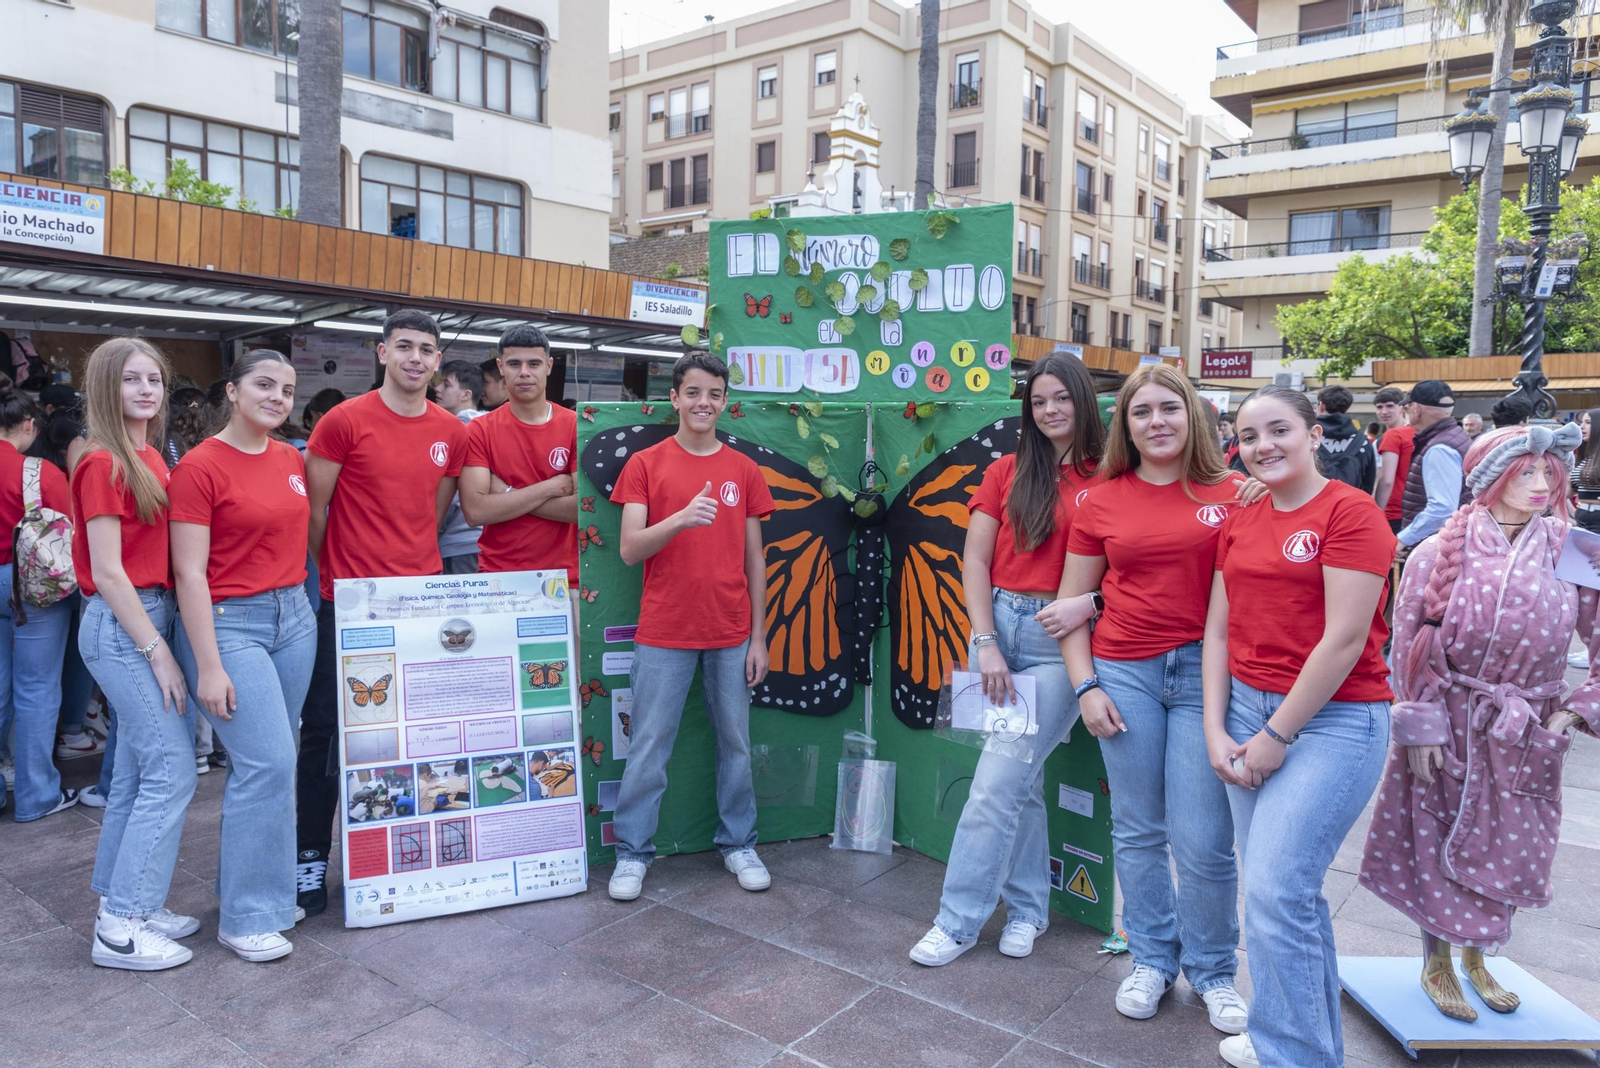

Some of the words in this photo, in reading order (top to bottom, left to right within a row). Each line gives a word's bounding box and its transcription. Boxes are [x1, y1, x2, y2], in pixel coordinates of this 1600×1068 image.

[0, 183, 82, 206] CIENCIA
[0, 210, 18, 225] io
[23, 213, 95, 235] Machado
[3, 226, 12, 236] la
[14, 228, 74, 245] Concepción)
[728, 234, 778, 276] EL
[645, 284, 699, 298] DIVERCIENCIA
[645, 301, 658, 312] IES
[659, 302, 693, 316] Saladillo
[819, 321, 842, 344] en
[883, 320, 901, 345] la
[425, 580, 461, 590] Ciencias
[462, 579, 489, 588] Puras
